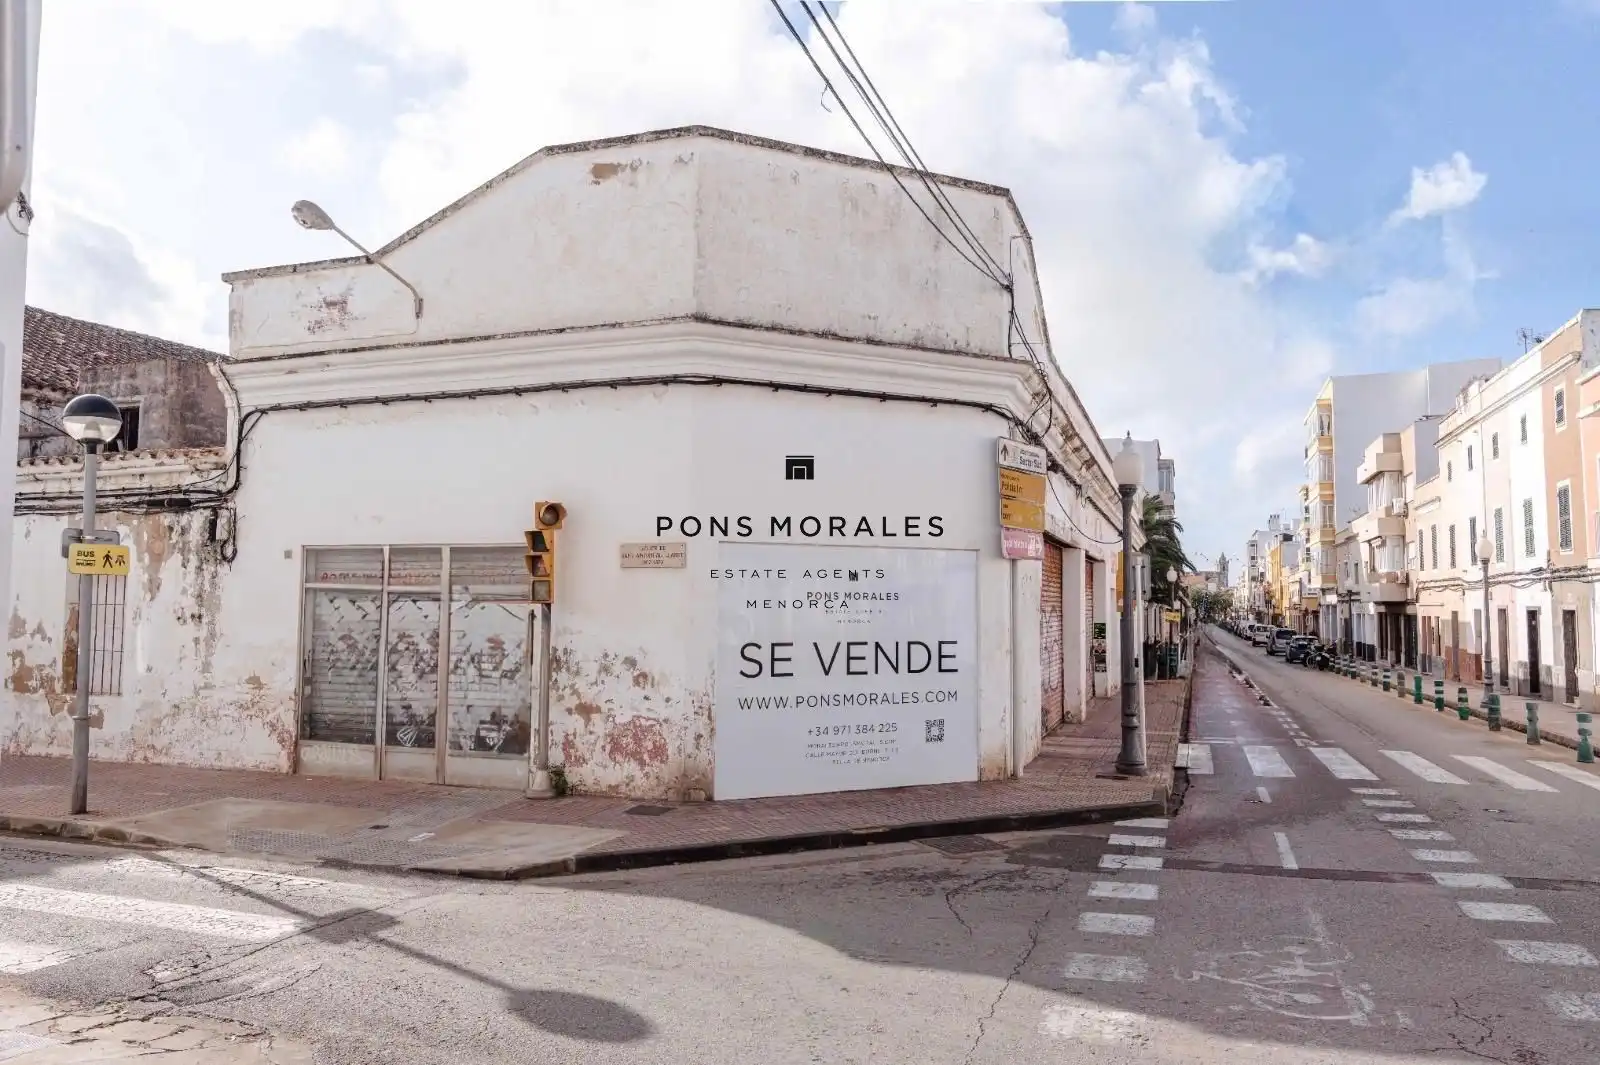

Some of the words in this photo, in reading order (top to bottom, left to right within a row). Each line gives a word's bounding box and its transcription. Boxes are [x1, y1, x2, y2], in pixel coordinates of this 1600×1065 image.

[76, 550, 95, 558] BUS
[806, 592, 840, 601] PONS
[844, 592, 899, 601] MORALES
[739, 642, 794, 679] SE
[812, 640, 959, 677] VENDE
[738, 690, 958, 710] WWW.PONSMORALES.COM
[807, 726, 829, 737] +34
[832, 724, 852, 736] 971
[854, 723, 876, 735] 384
[878, 722, 898, 733] 225
